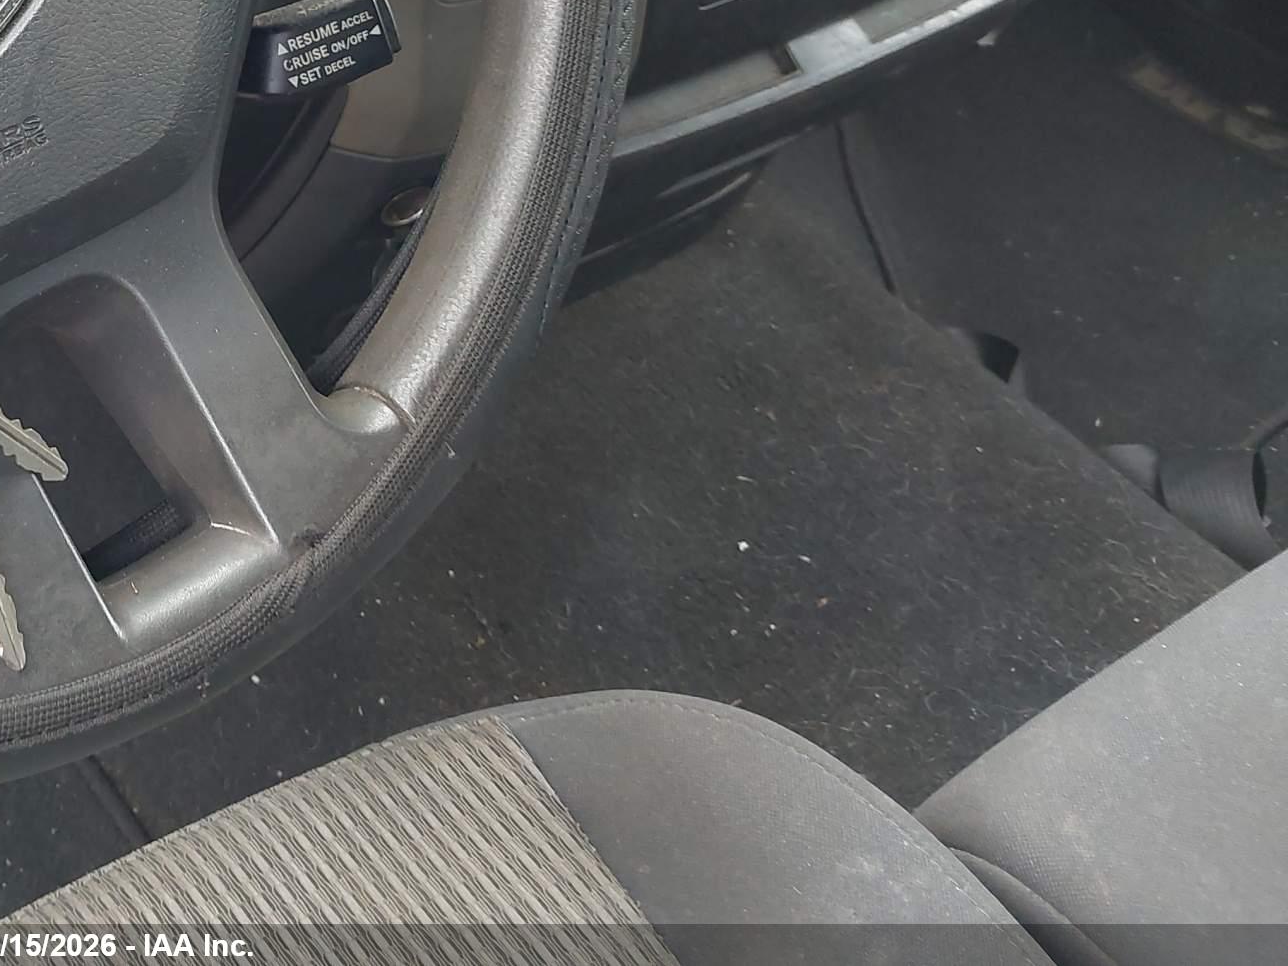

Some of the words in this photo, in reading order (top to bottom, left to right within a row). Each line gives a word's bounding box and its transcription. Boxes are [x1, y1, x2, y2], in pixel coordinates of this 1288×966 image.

[283, 46, 329, 71] CRUISE
[331, 30, 369, 53] ON/OFF
[288, 21, 340, 51] RESUME
[341, 11, 373, 31] ACCEL
[300, 66, 322, 85] SET
[325, 56, 356, 75] DECEL
